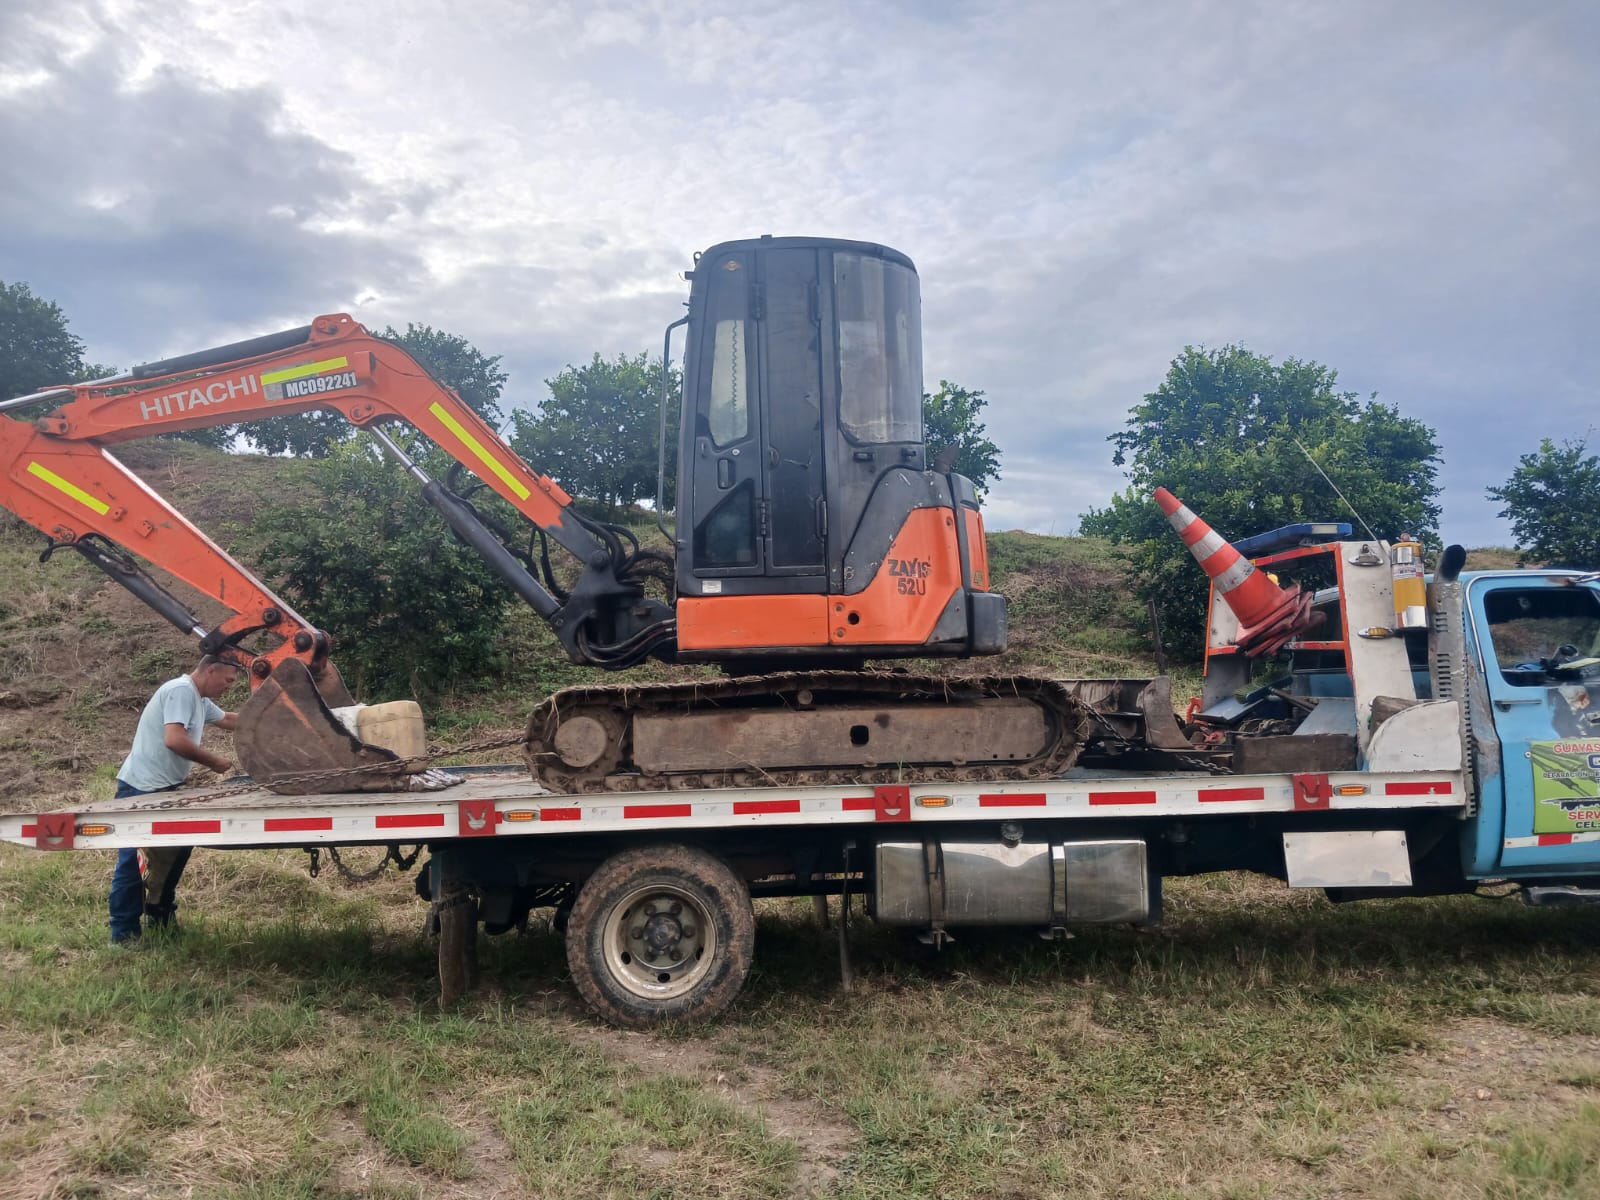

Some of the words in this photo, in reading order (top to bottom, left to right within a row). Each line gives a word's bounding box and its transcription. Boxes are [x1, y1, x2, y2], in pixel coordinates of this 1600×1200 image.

[139, 374, 258, 420] HITACHI
[286, 372, 358, 398] MC092241
[897, 578, 926, 596] 52U
